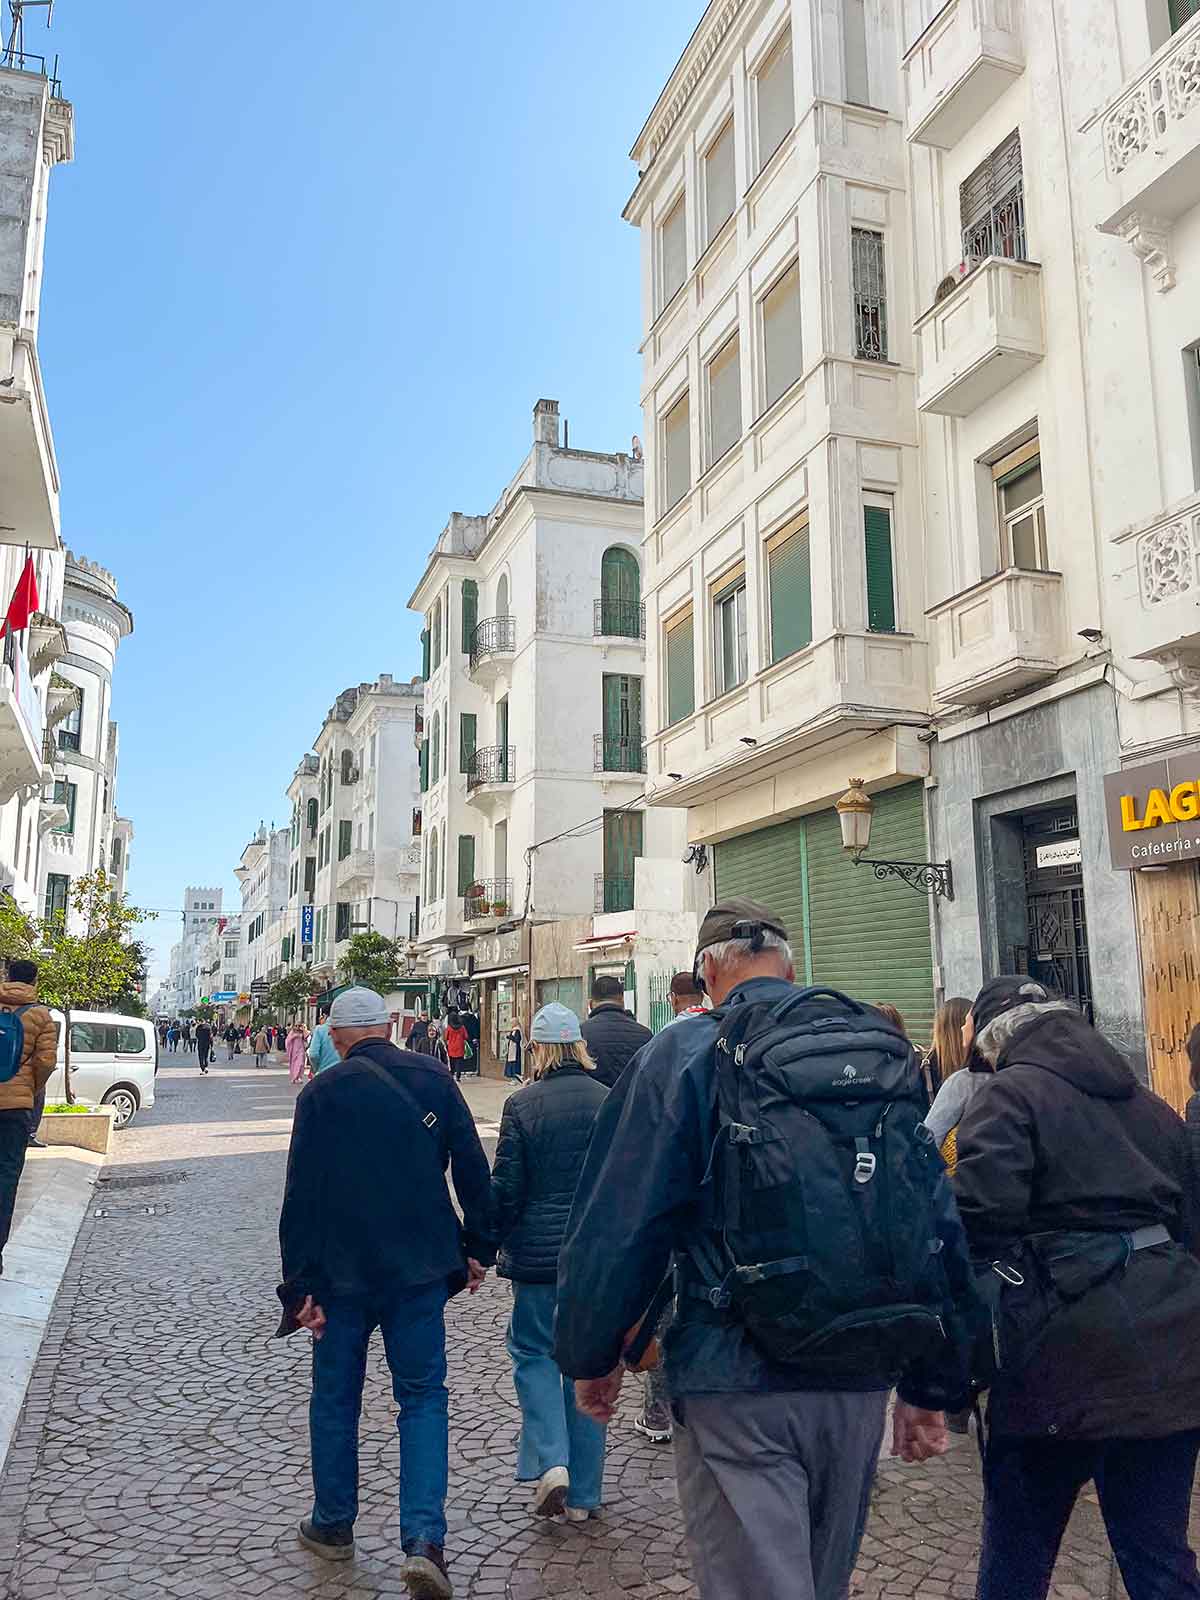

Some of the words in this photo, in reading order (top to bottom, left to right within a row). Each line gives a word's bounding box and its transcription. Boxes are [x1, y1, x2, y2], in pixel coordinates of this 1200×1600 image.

[1120, 779, 1200, 832] LAG
[1131, 838, 1191, 858] Cafeteria
[304, 906, 312, 942] HOTEL
